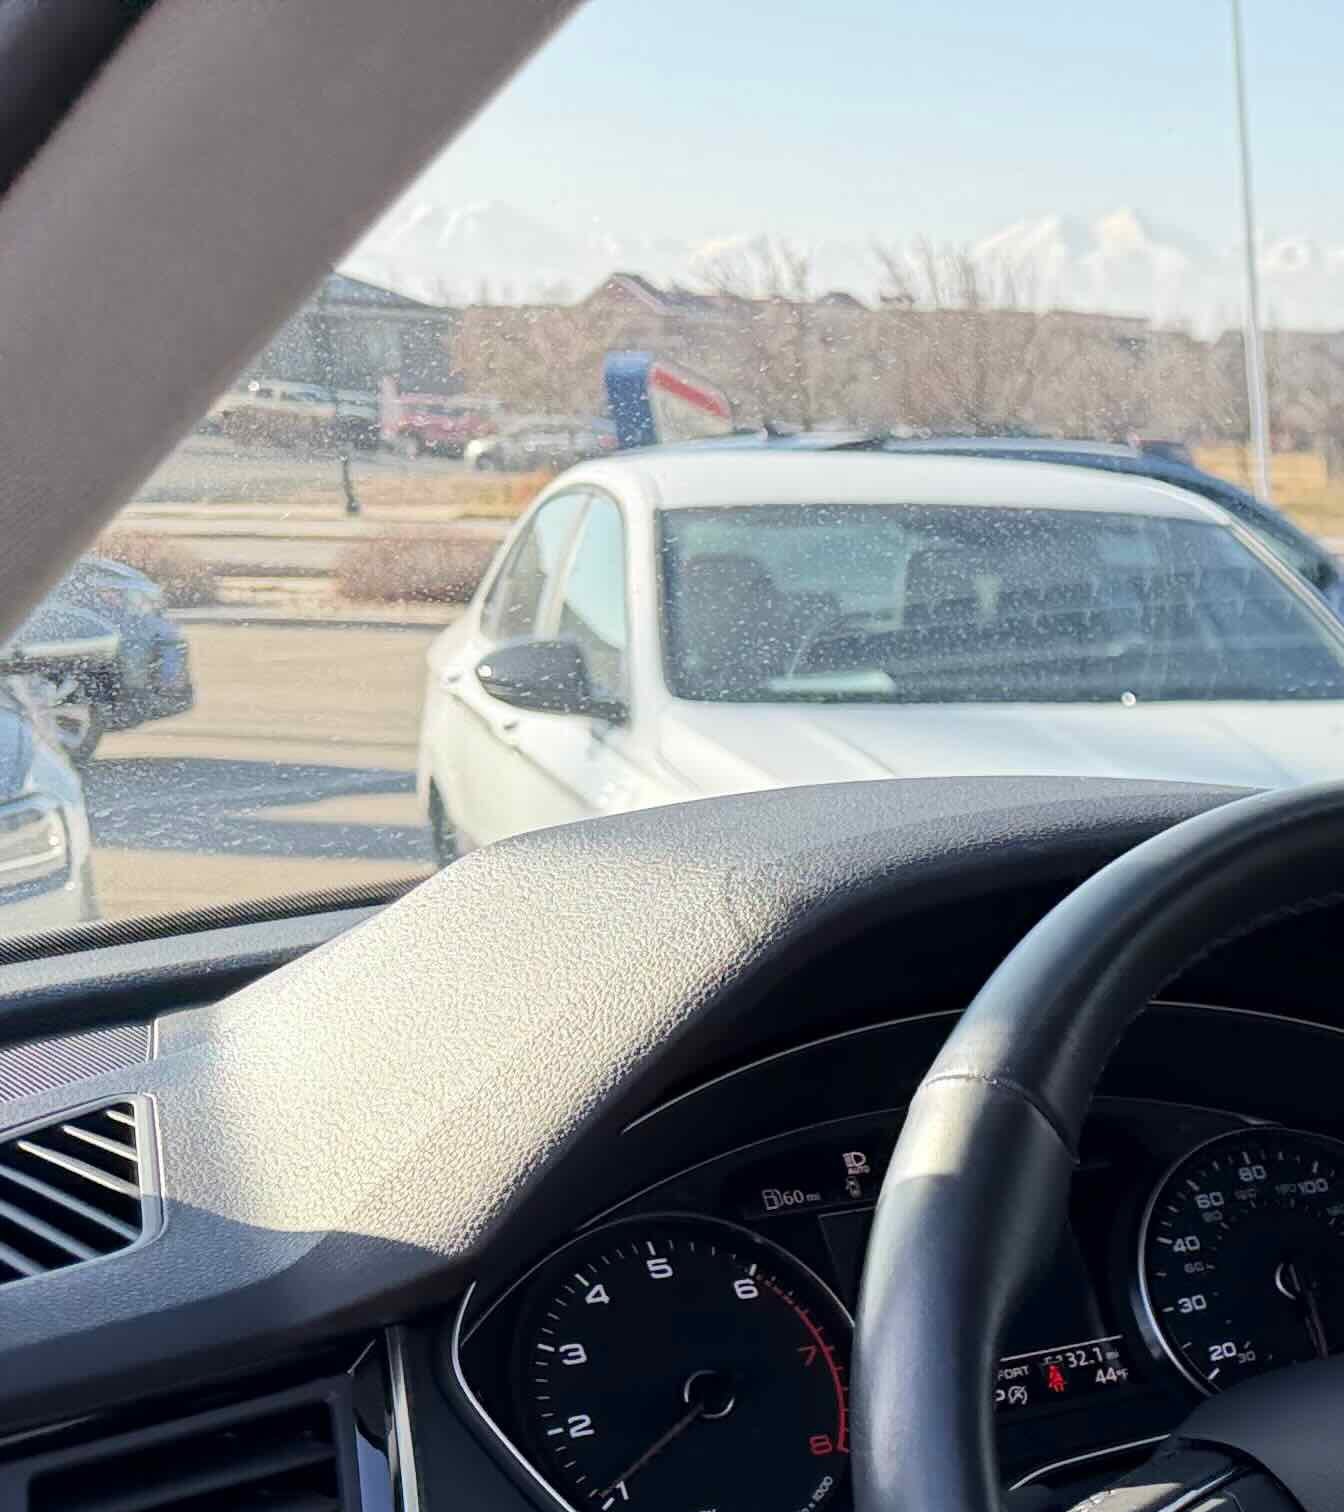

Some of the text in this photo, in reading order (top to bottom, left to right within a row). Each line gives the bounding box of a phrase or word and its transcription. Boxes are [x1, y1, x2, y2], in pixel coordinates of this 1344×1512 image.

[1237, 1164, 1267, 1183] 80
[1297, 1177, 1329, 1194] 100
[783, 1190, 805, 1206] 60
[1194, 1191, 1225, 1209] 60
[1172, 1235, 1201, 1253] 40
[646, 1257, 674, 1280] 5
[584, 1283, 611, 1305] 4
[733, 1277, 760, 1300] 6
[1177, 1293, 1208, 1314] 30
[559, 1343, 588, 1366] 3
[797, 1347, 817, 1366] 7
[1065, 1346, 1105, 1369] 32.1
[1208, 1341, 1237, 1362] 20
[1237, 1350, 1257, 1365] 30
[567, 1414, 595, 1438] 2
[808, 1434, 834, 1456] 8
[615, 1480, 631, 1502] 1
[812, 1475, 834, 1502] 1000
